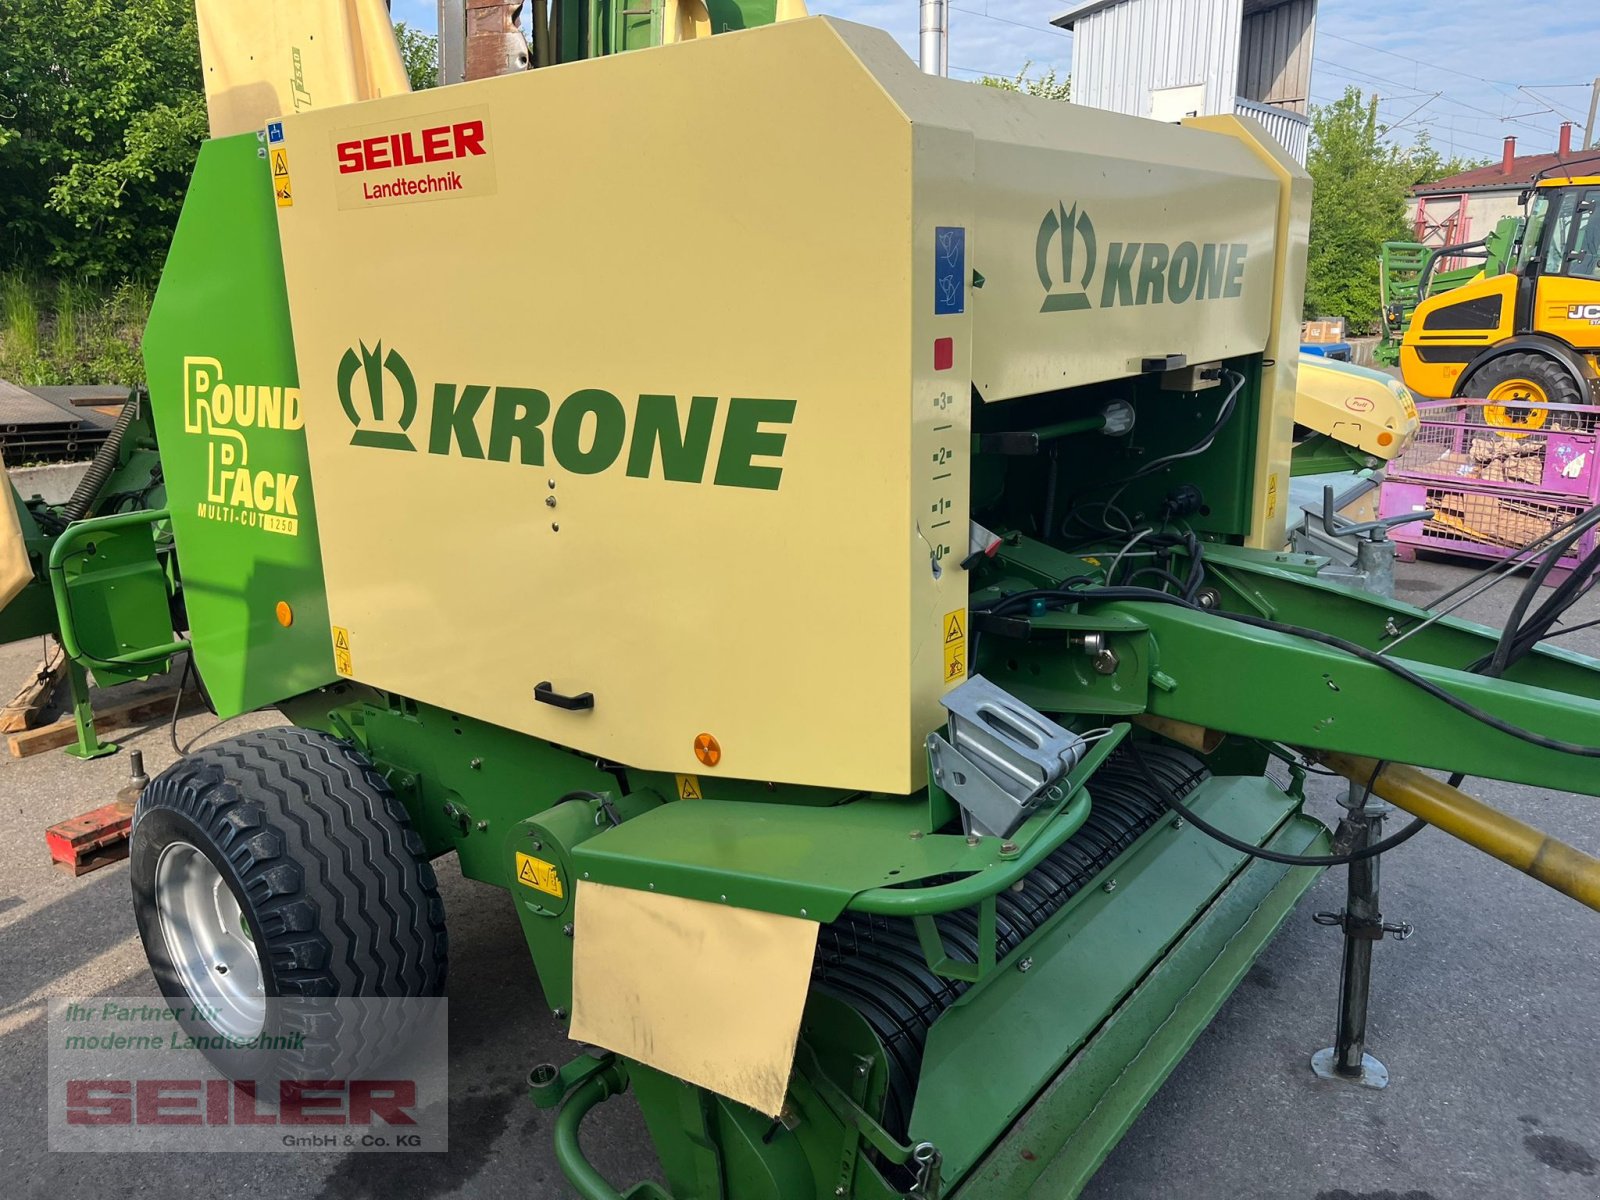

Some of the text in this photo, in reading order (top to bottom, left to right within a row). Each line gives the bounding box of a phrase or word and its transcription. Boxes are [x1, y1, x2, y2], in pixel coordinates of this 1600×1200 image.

[337, 120, 487, 174] SEILER
[363, 171, 463, 199] Landtechnik
[1099, 241, 1248, 308] KRONE
[184, 356, 305, 434] ROUND
[428, 382, 798, 491] KRONE
[208, 427, 299, 516] PACK
[198, 503, 293, 532] MULTI-CUT 1250
